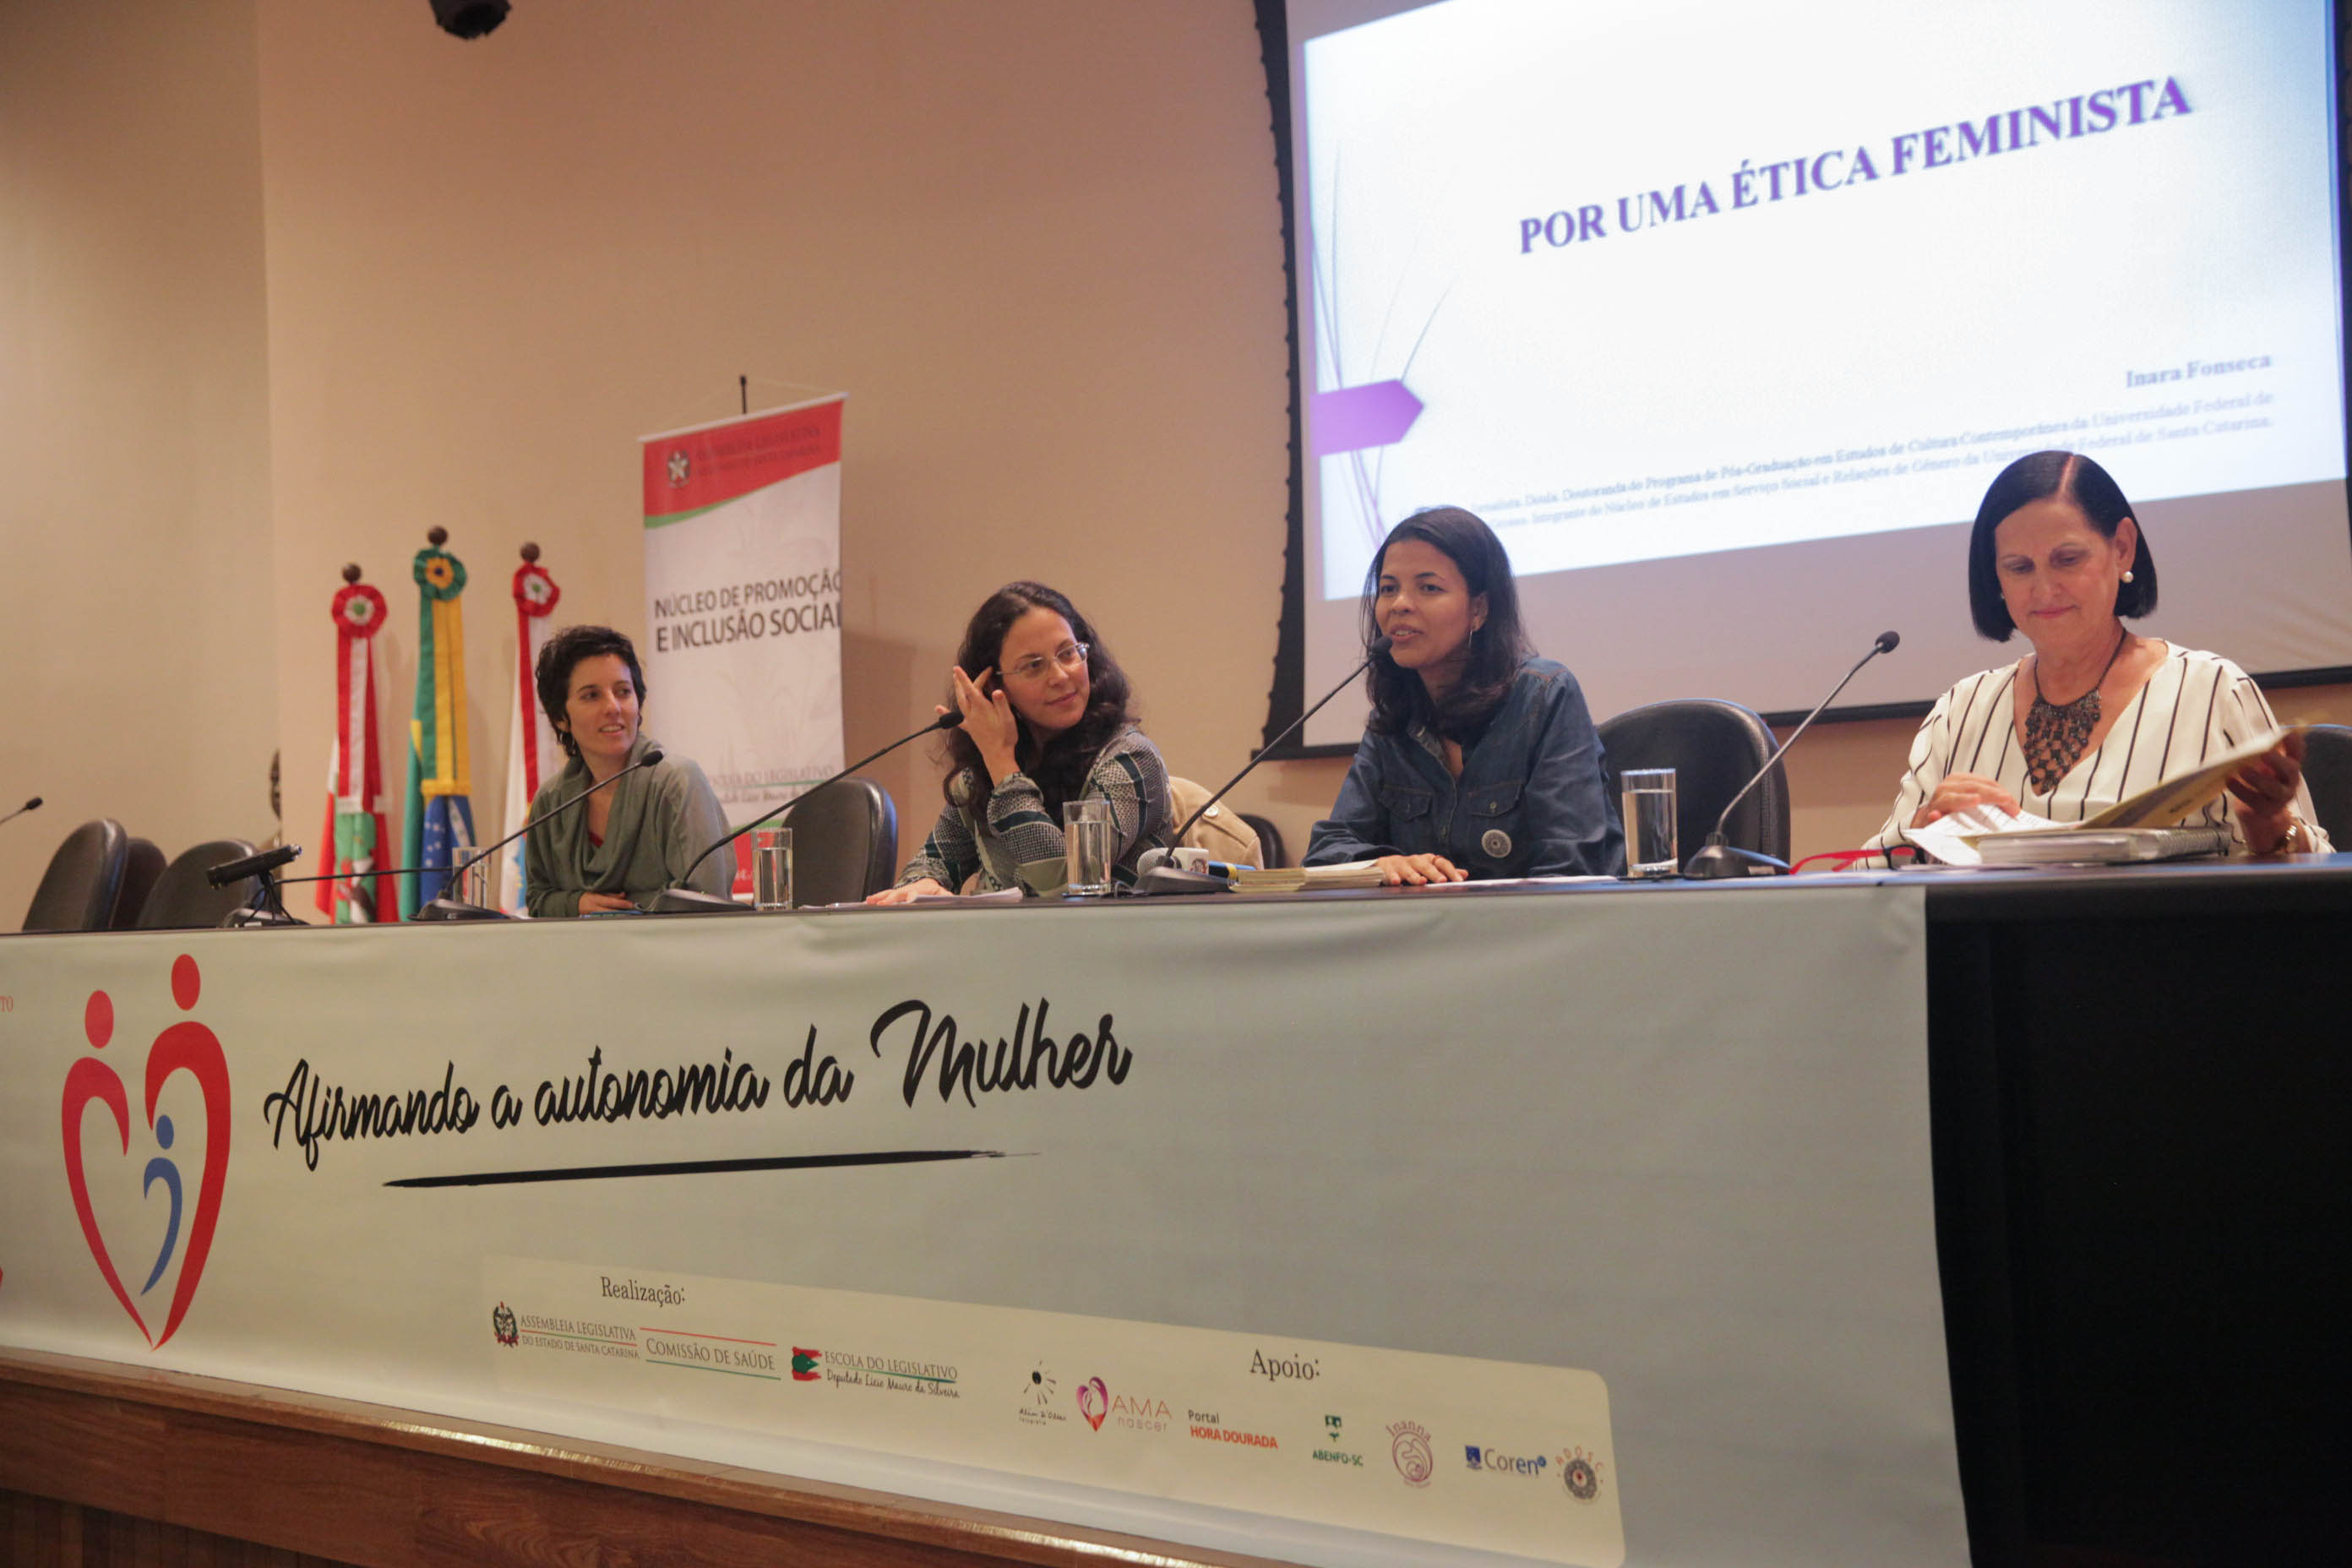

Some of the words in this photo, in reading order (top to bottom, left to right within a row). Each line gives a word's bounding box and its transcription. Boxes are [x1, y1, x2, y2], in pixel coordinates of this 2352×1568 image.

[1521, 204, 1606, 253] POR
[1617, 181, 1718, 234] UMA
[1731, 145, 1881, 210] ÉTICA
[1891, 75, 2193, 176] FEMINISTA
[2126, 368, 2182, 389] Inara
[2187, 355, 2273, 379] Fonseca
[1645, 472, 1701, 490] Programa
[1704, 471, 1718, 482] de
[1836, 445, 1886, 462] Estudos
[1889, 443, 1905, 455] de
[1908, 436, 1957, 452] Cultura
[2072, 416, 2088, 429] da
[2092, 401, 2189, 427] Universidade
[2194, 393, 2250, 413] Federal
[2254, 391, 2273, 405] de
[1664, 489, 1708, 507] Estudos
[1782, 474, 1819, 489] Social
[2078, 433, 2132, 452] Federal
[2135, 430, 2153, 443] de
[2158, 422, 2199, 440] Santa
[655, 589, 716, 618] NÚCLEO
[720, 585, 740, 609] DE
[657, 625, 667, 652] E
[672, 608, 765, 651] INCLUSÃO
[264, 1058, 480, 1172] Afirmando
[491, 1084, 523, 1130] a
[534, 1044, 770, 1126] autonomia
[783, 1023, 855, 1109] da
[869, 997, 1133, 1109] Mulher
[601, 1276, 685, 1308] Realização:
[520, 1315, 575, 1334] ASSEMBLEIA
[576, 1320, 636, 1341] LEGISLATIVA
[521, 1335, 534, 1347] DO
[535, 1336, 564, 1350] ESTADO
[564, 1339, 575, 1353] DE
[576, 1340, 600, 1354] SANTA
[601, 1344, 640, 1360] CATARINA
[645, 1337, 710, 1363] COMISSÃO
[714, 1348, 731, 1365] DE
[733, 1349, 776, 1371] SAÚDE
[825, 1351, 864, 1369] ESCOLA
[866, 1356, 885, 1371] DO
[887, 1358, 958, 1380] LEGISLATIVO
[1250, 1349, 1320, 1382] Apoio:
[827, 1368, 863, 1389] Deputado
[928, 1380, 961, 1399] Silveira
[1112, 1394, 1173, 1420] AMA
[1188, 1409, 1219, 1424] Portal
[1118, 1416, 1168, 1434] nascer
[1190, 1425, 1222, 1441] HORA
[1223, 1429, 1279, 1450] DOURADA
[1312, 1448, 1364, 1467] ABENFO-SC
